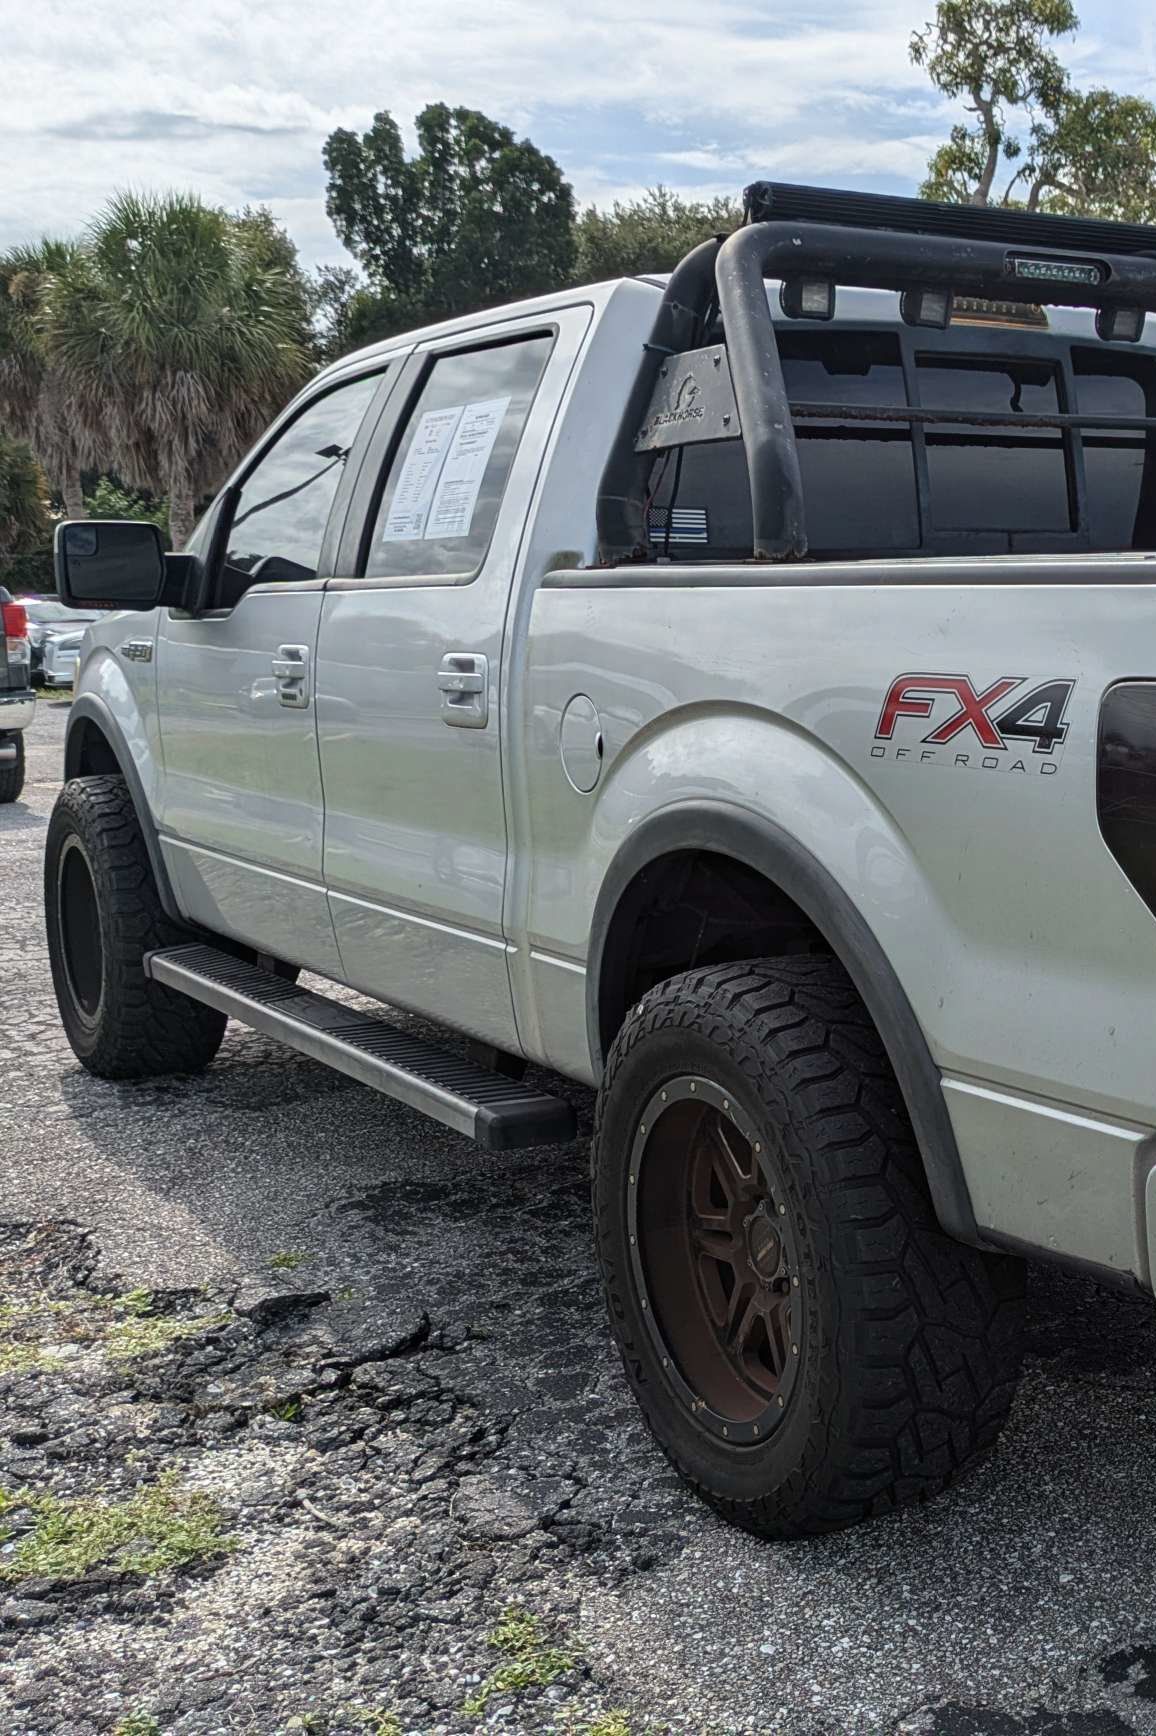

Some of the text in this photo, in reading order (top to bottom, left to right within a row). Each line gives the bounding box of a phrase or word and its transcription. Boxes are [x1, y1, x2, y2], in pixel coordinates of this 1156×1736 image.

[874, 671, 1076, 754] FX4
[870, 745, 1058, 775] OFF ROAD
